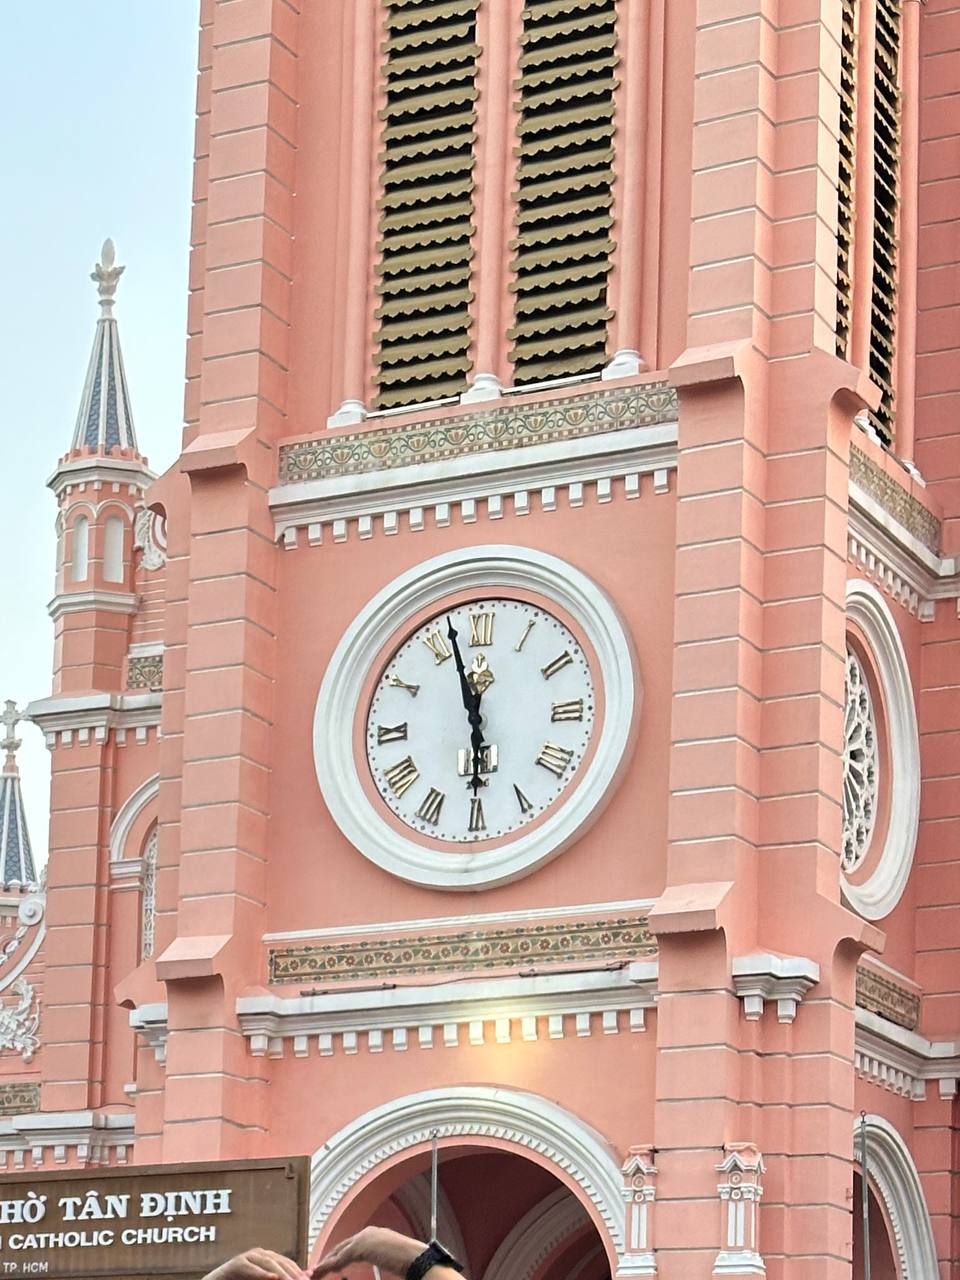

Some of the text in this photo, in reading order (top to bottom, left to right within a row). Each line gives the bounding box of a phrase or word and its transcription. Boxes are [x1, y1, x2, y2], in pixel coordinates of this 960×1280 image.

[468, 612, 495, 647] XII
[514, 620, 536, 652] I
[423, 629, 452, 665] XI
[541, 650, 573, 680] II
[390, 674, 420, 698] X
[551, 699, 583, 722] III
[378, 722, 408, 745] IX
[384, 755, 420, 800] VIII
[513, 783, 533, 813] V
[468, 798, 487, 832] VI
[58, 1190, 131, 1221] TÂN
[140, 1189, 232, 1222] ĐỊNH
[8, 1230, 114, 1250] CATHOLIC
[121, 1226, 216, 1245] CHURCH
[22, 1262, 49, 1273] HCM
